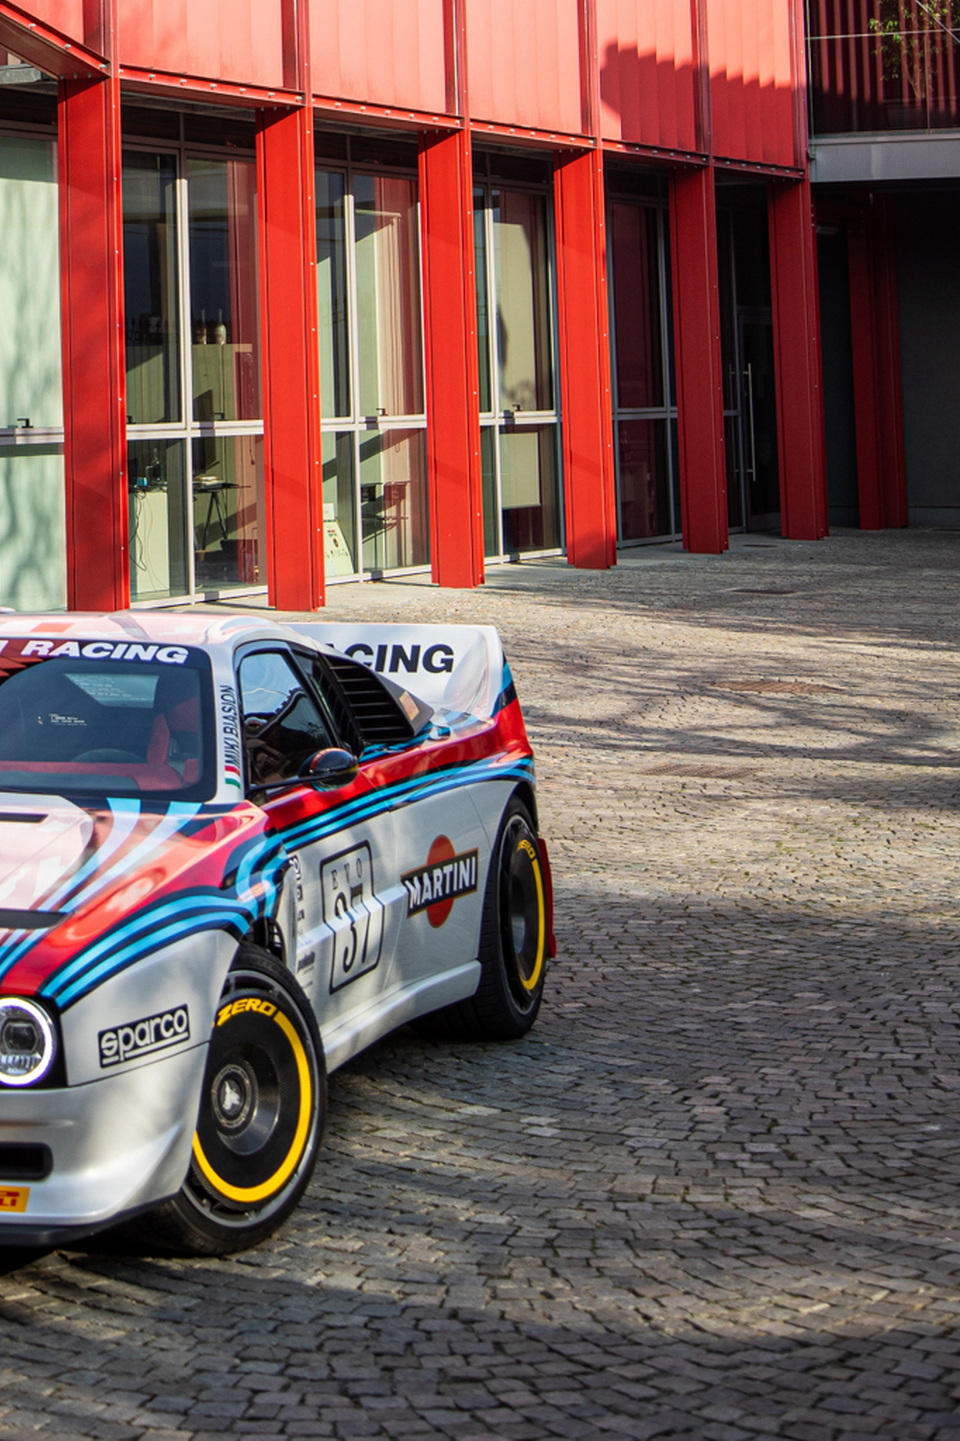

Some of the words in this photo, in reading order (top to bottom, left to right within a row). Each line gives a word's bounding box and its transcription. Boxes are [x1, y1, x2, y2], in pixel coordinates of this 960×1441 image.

[20, 640, 189, 664] RACING
[326, 643, 454, 673] CING
[220, 684, 239, 738] BIASION
[331, 858, 363, 890] EVO
[404, 856, 476, 909] MARTINI
[335, 883, 372, 973] 37
[216, 998, 277, 1027] ZERO
[101, 1009, 188, 1061] sparco
